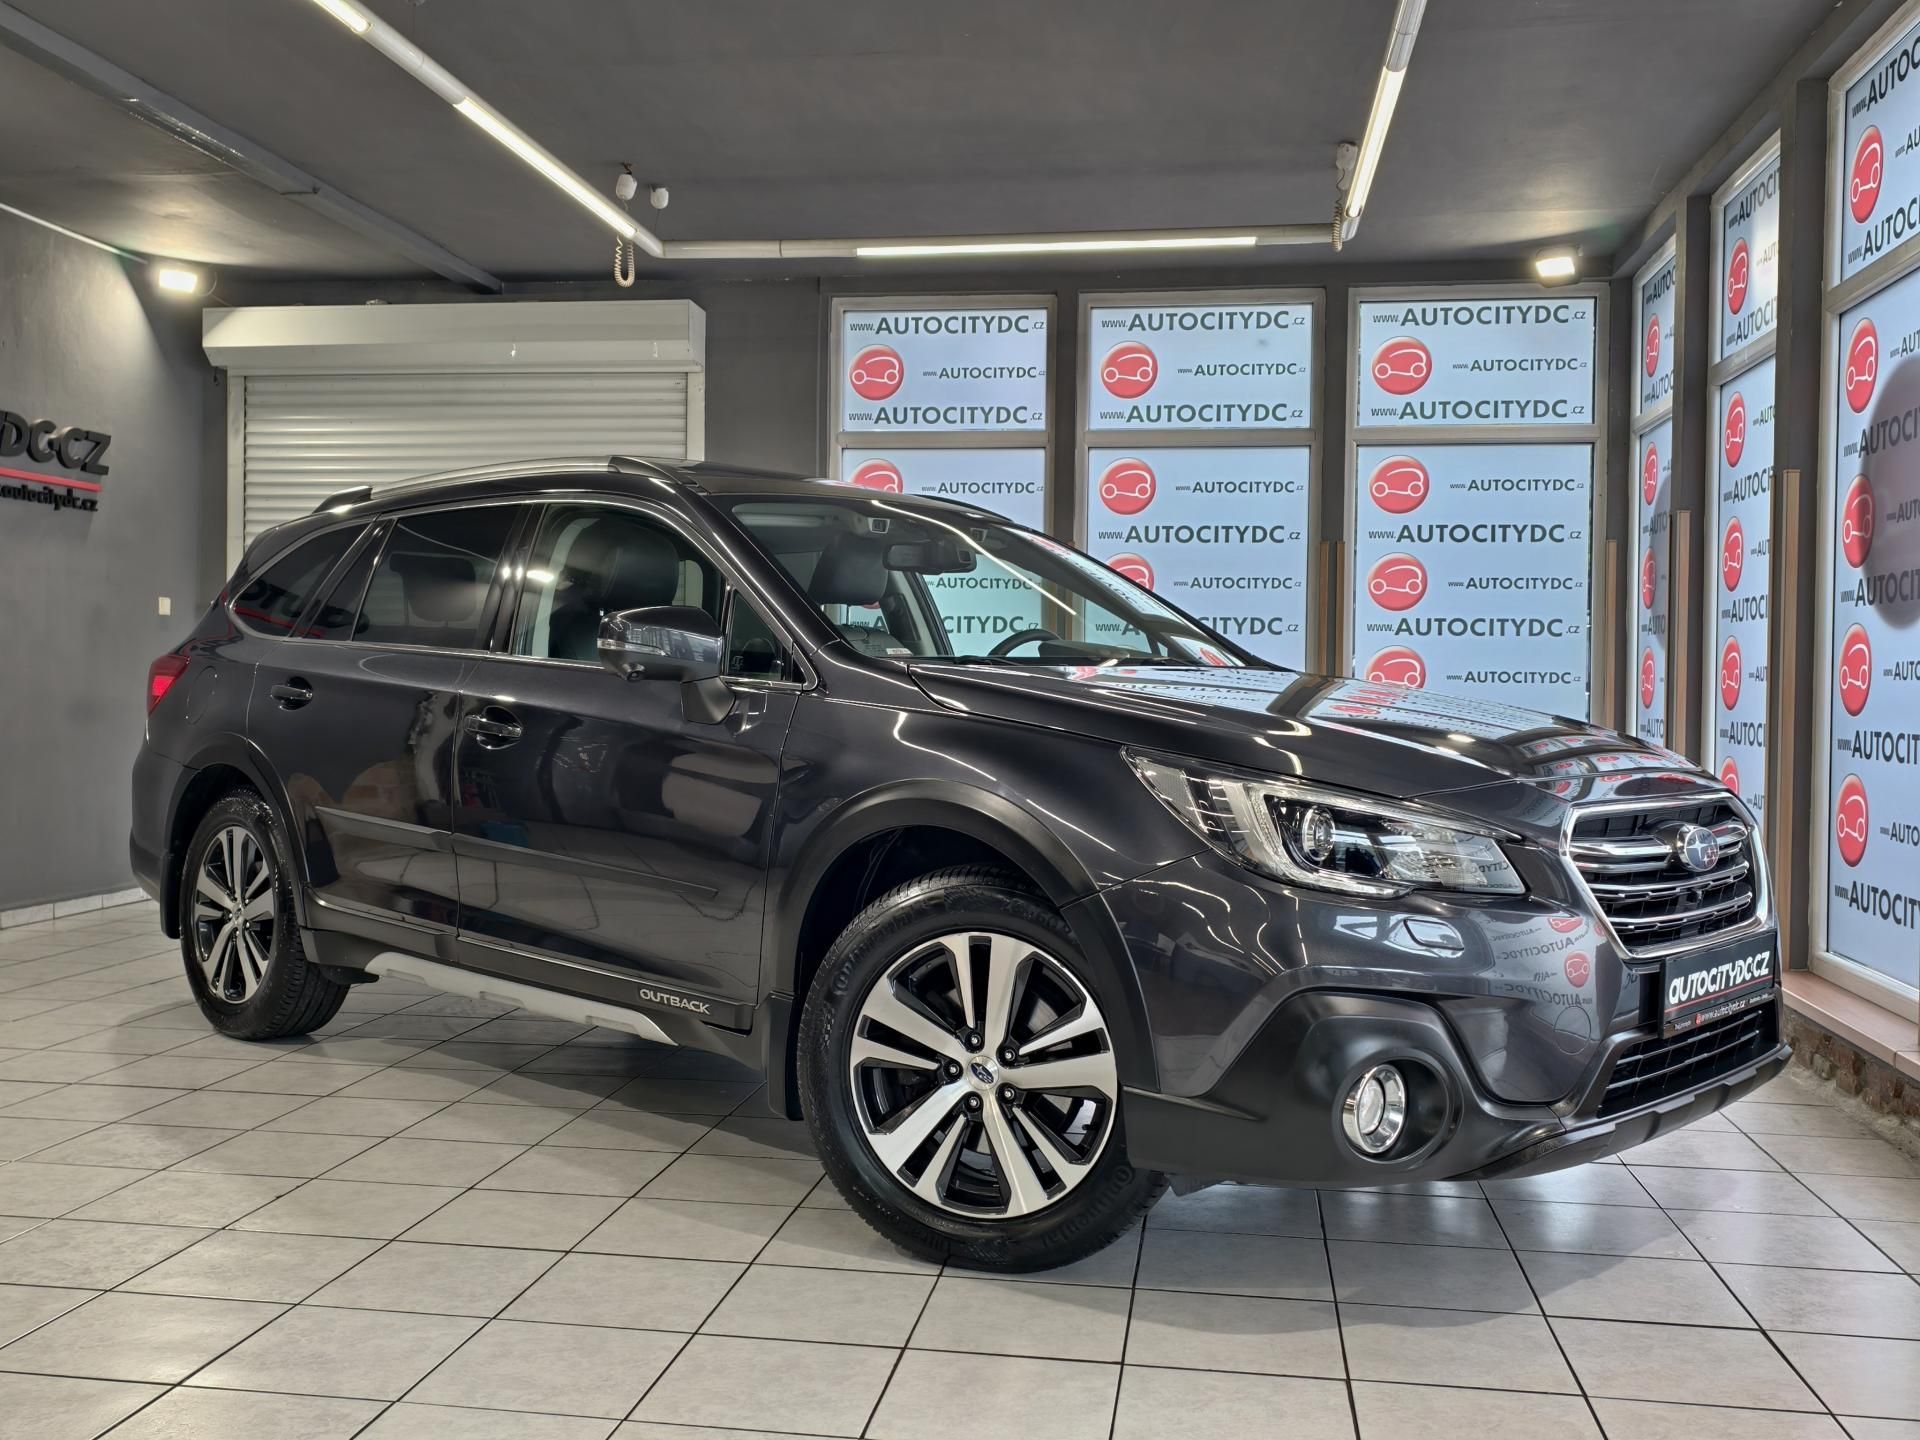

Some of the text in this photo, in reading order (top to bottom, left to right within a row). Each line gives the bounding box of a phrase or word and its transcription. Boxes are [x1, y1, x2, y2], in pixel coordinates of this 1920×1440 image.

[850, 315, 1044, 335] www.AUTOCITYDC.cz
[1101, 310, 1305, 332] www.AUTOCITYDC.cz
[1373, 304, 1586, 327] www.AUTOCITYDC.cz
[848, 406, 1043, 424] www.AUTOCITYDC.cz
[1100, 403, 1303, 423] www.AUTOCITYDC.cz
[1371, 399, 1584, 420] www.AUTOCITYDC.cz
[1098, 525, 1301, 544] www.AUTOCITYDC.cz
[1368, 524, 1581, 543] www.AUTOCITYDC.cz
[1366, 618, 1580, 637] www.AUTOCITYDC.cz
[640, 989, 711, 1015] OUTBACK
